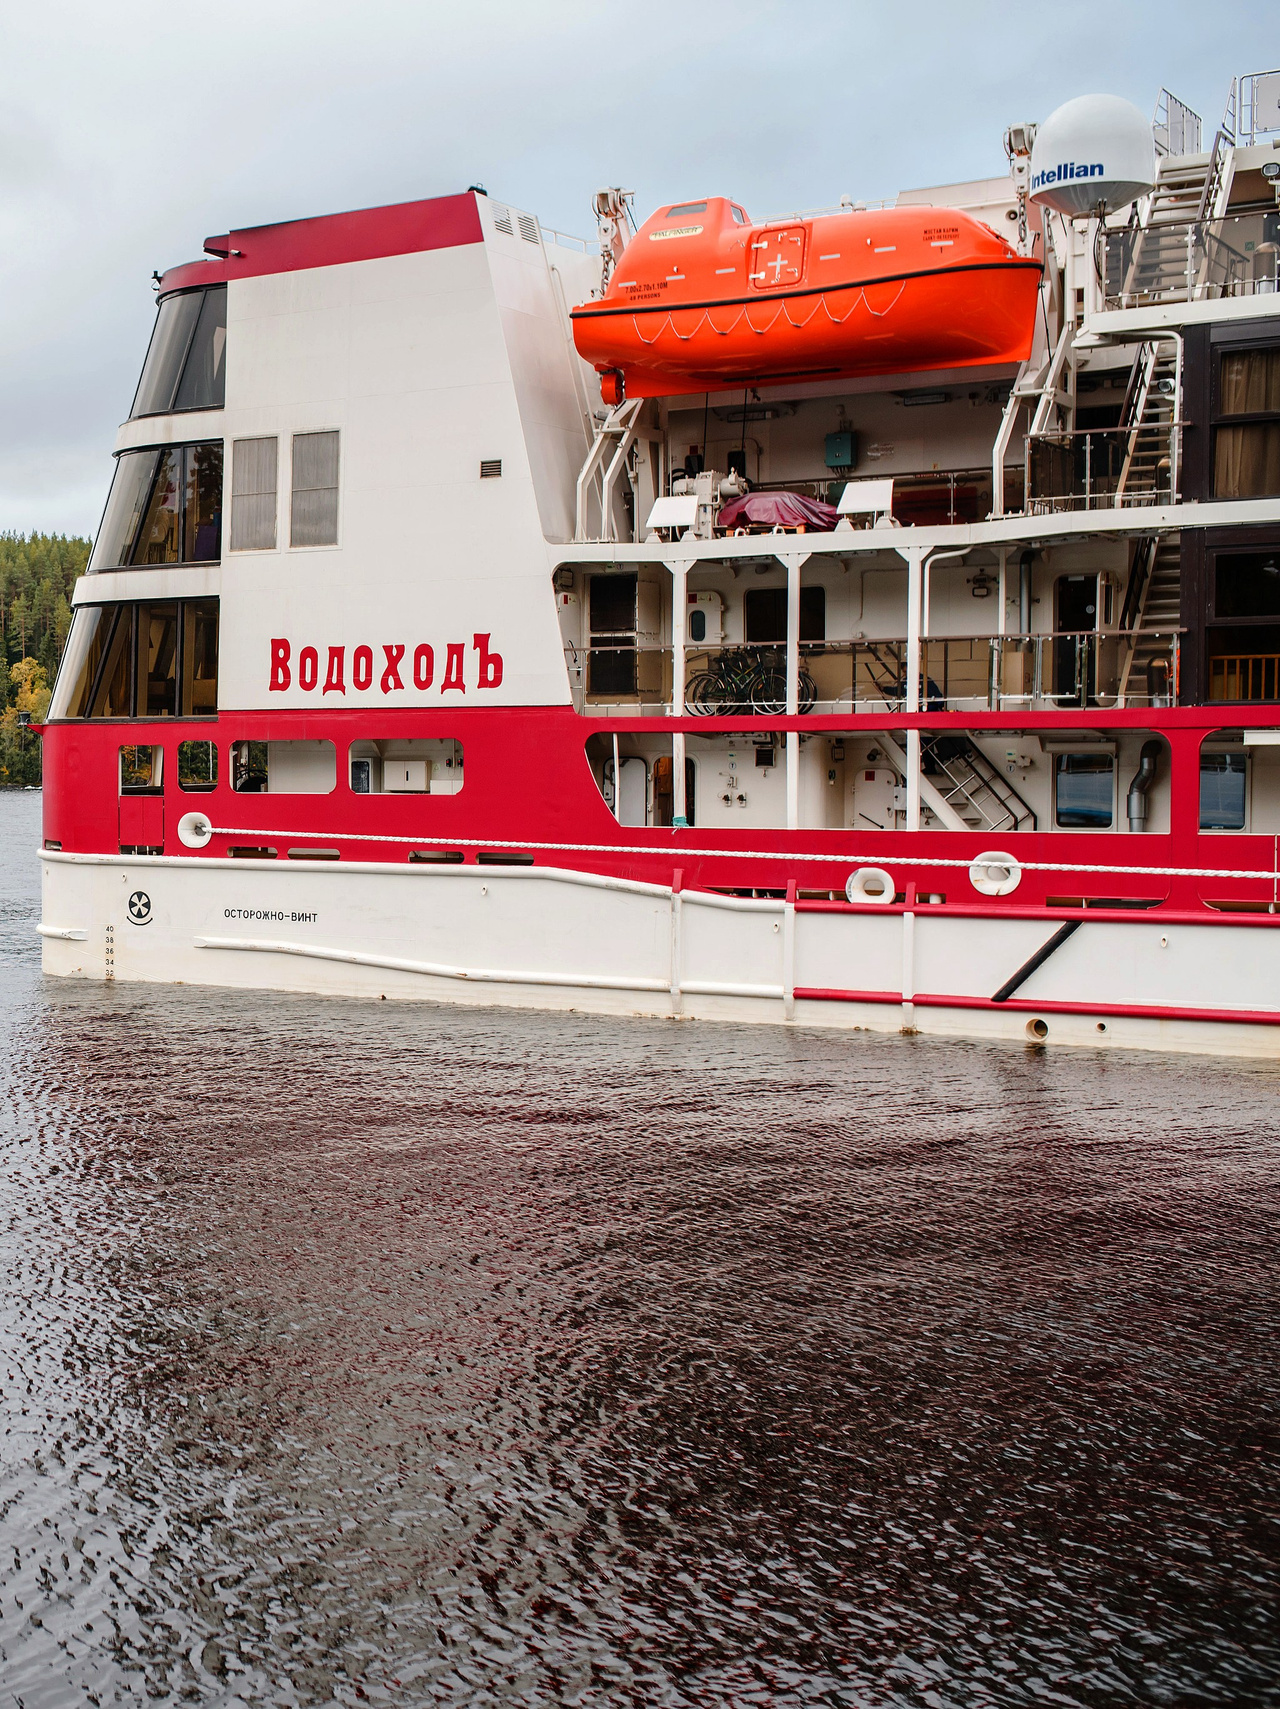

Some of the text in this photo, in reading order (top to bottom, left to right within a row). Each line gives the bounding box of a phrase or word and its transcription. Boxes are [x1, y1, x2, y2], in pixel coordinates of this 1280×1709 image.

[1031, 162, 1104, 190] Intellian
[637, 292, 661, 300] PERSONS
[224, 908, 318, 923] ОСТОРОЖНО-ВИНТ
[105, 925, 114, 933] 40
[105, 936, 114, 944] 38
[105, 947, 114, 955] 36
[105, 958, 114, 966] 34
[105, 969, 114, 977] 32
